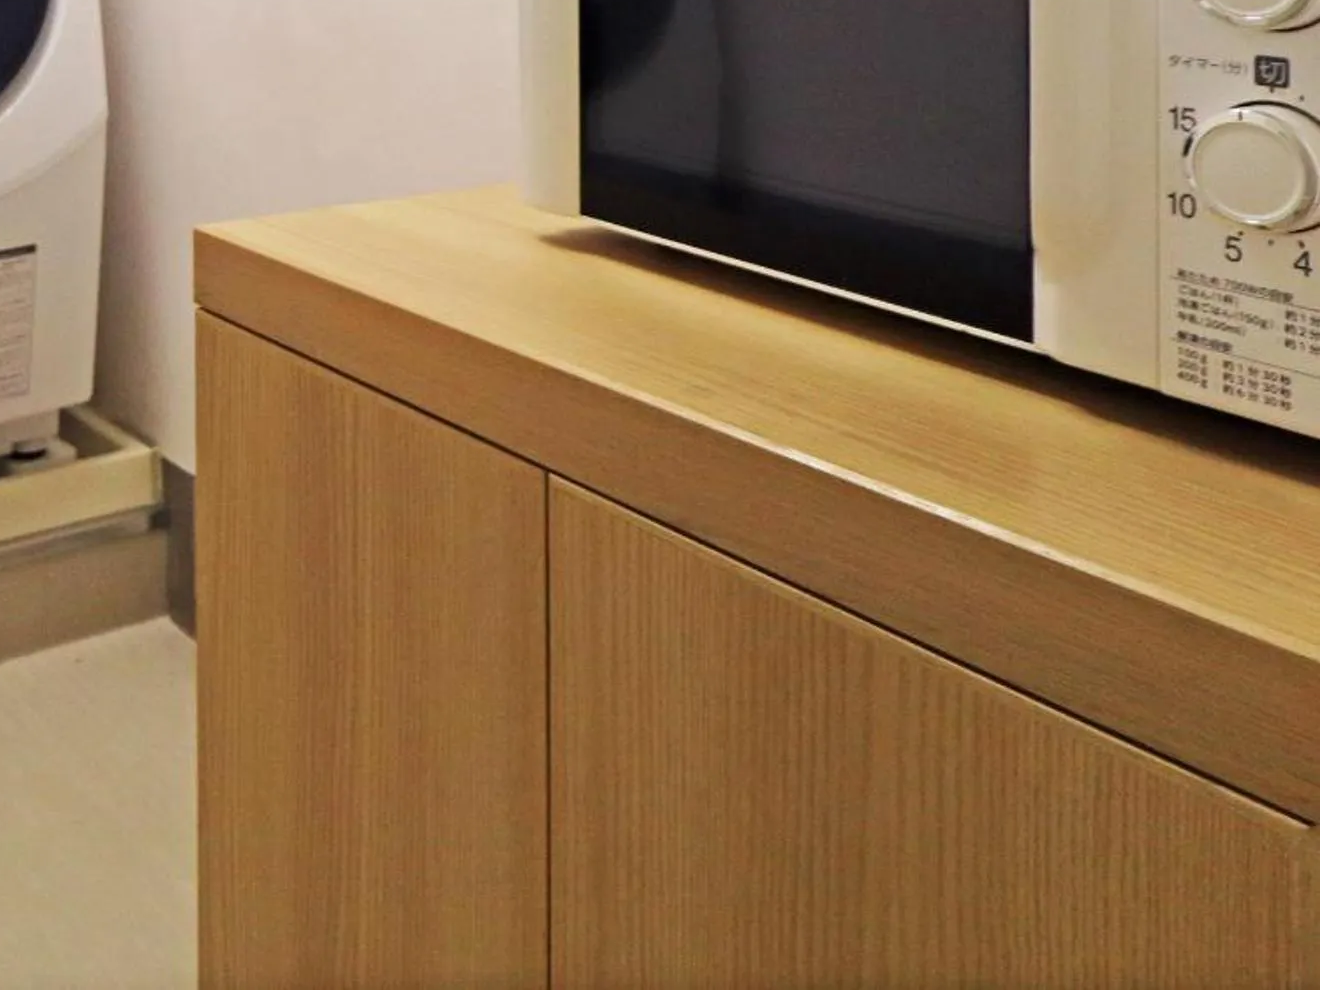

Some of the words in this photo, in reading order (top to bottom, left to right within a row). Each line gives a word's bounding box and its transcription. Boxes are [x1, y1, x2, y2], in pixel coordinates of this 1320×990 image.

[1258, 59, 1287, 86] 切
[1169, 106, 1197, 132] 15
[1167, 192, 1197, 218] 10
[1224, 235, 1243, 262] 5
[1293, 250, 1313, 278] 4
